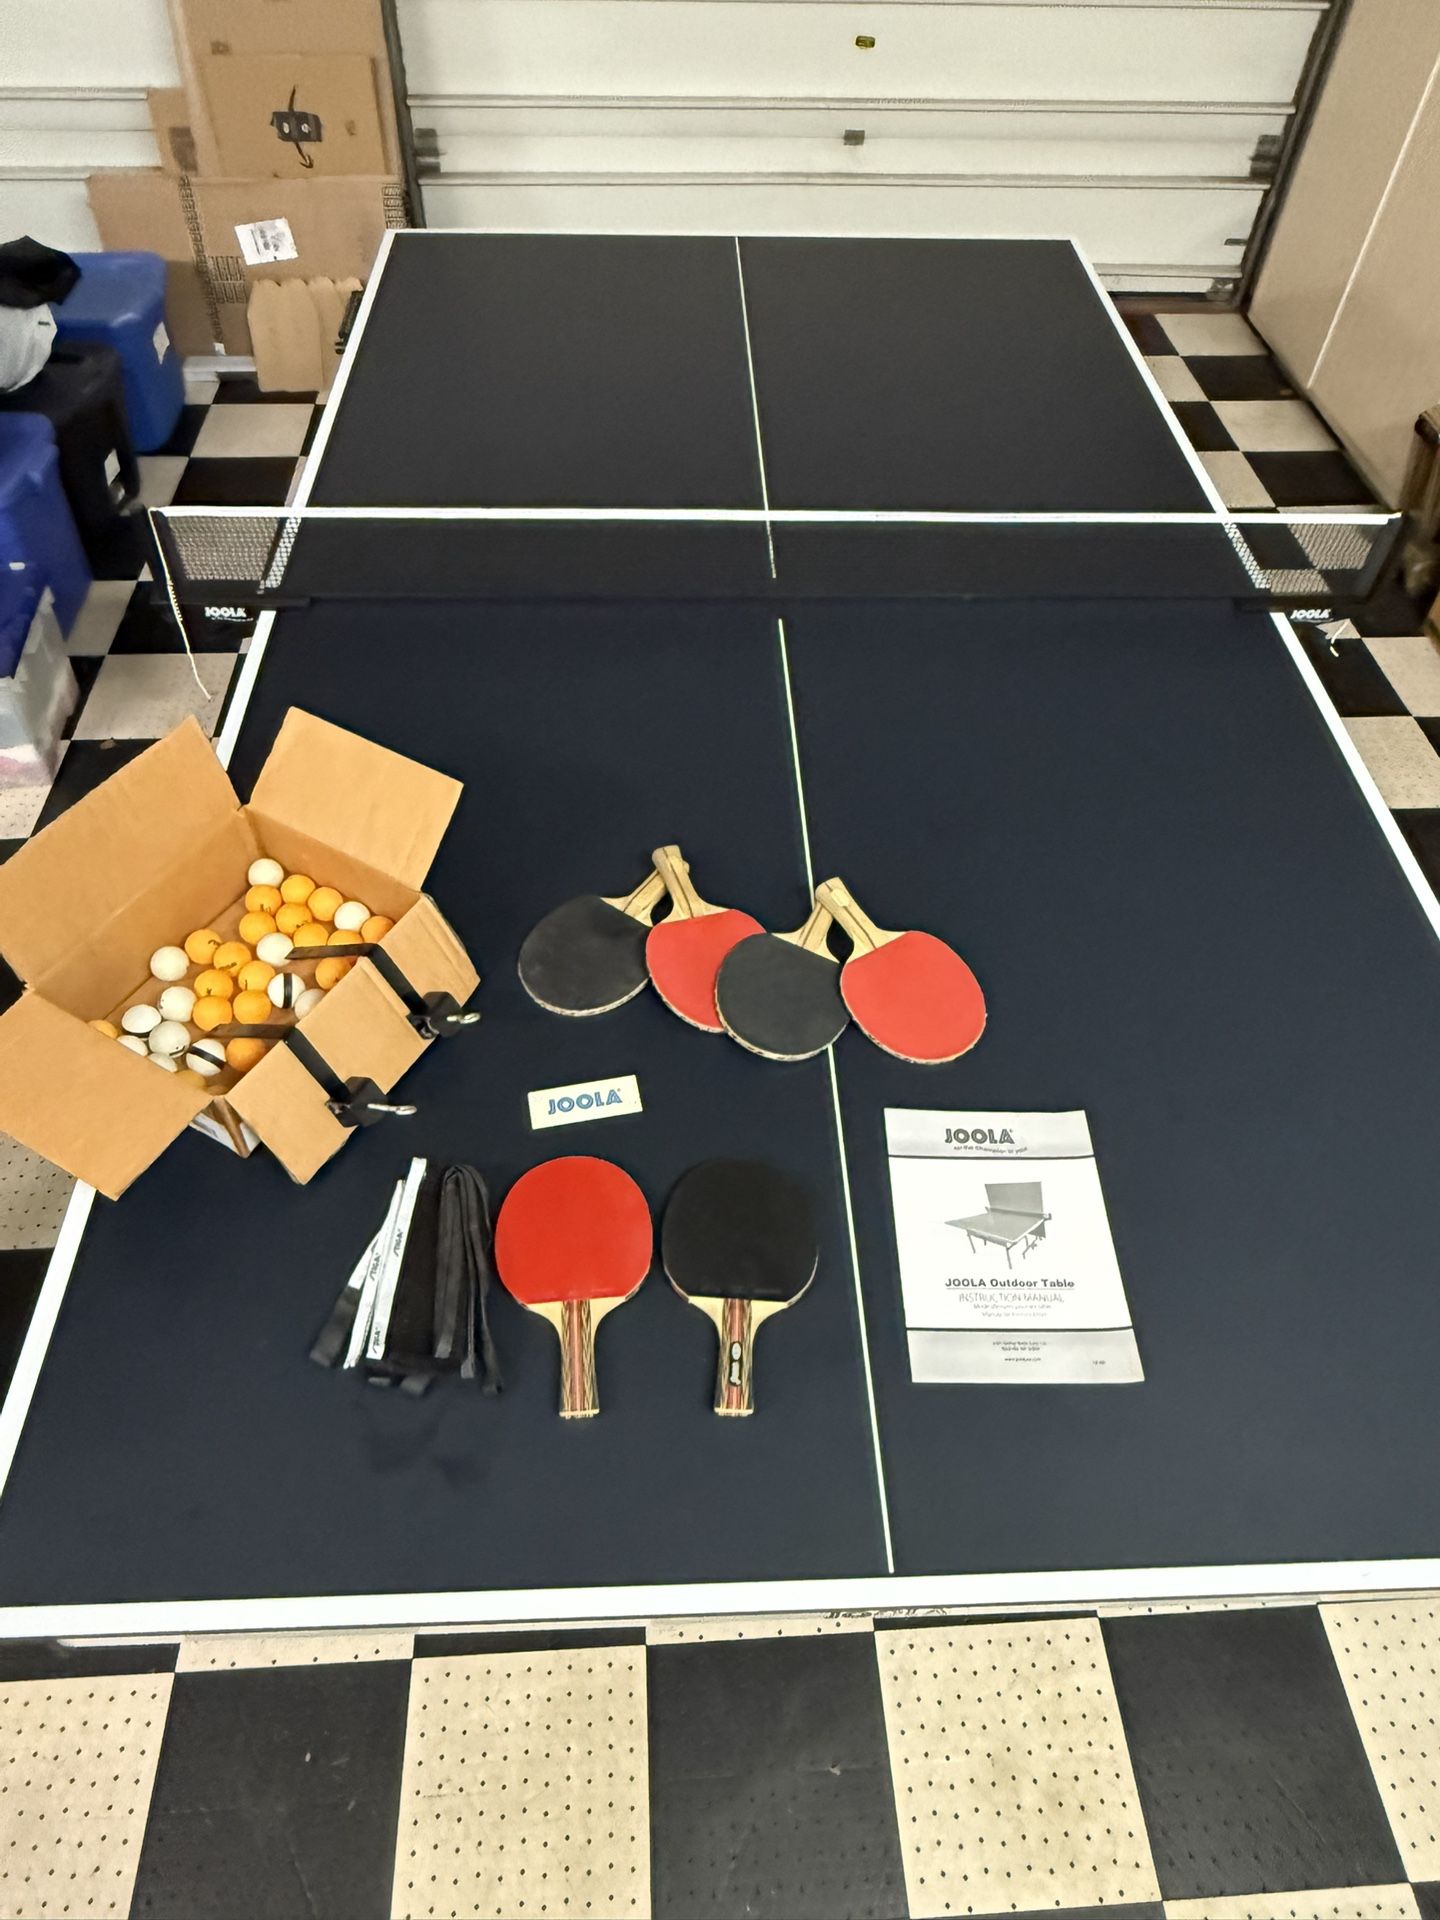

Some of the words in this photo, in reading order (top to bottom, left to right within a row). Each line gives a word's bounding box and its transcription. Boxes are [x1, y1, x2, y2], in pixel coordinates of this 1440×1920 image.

[204, 606, 247, 618] JOOLA
[1290, 608, 1331, 619] JOOLA
[548, 1089, 622, 1115] JOOLA
[945, 1128, 1015, 1145] JOOLA
[369, 1252, 381, 1281] STIGA
[945, 1278, 987, 1288] JOOLA
[990, 1278, 1038, 1288] Outdoor
[1040, 1278, 1075, 1288] Table
